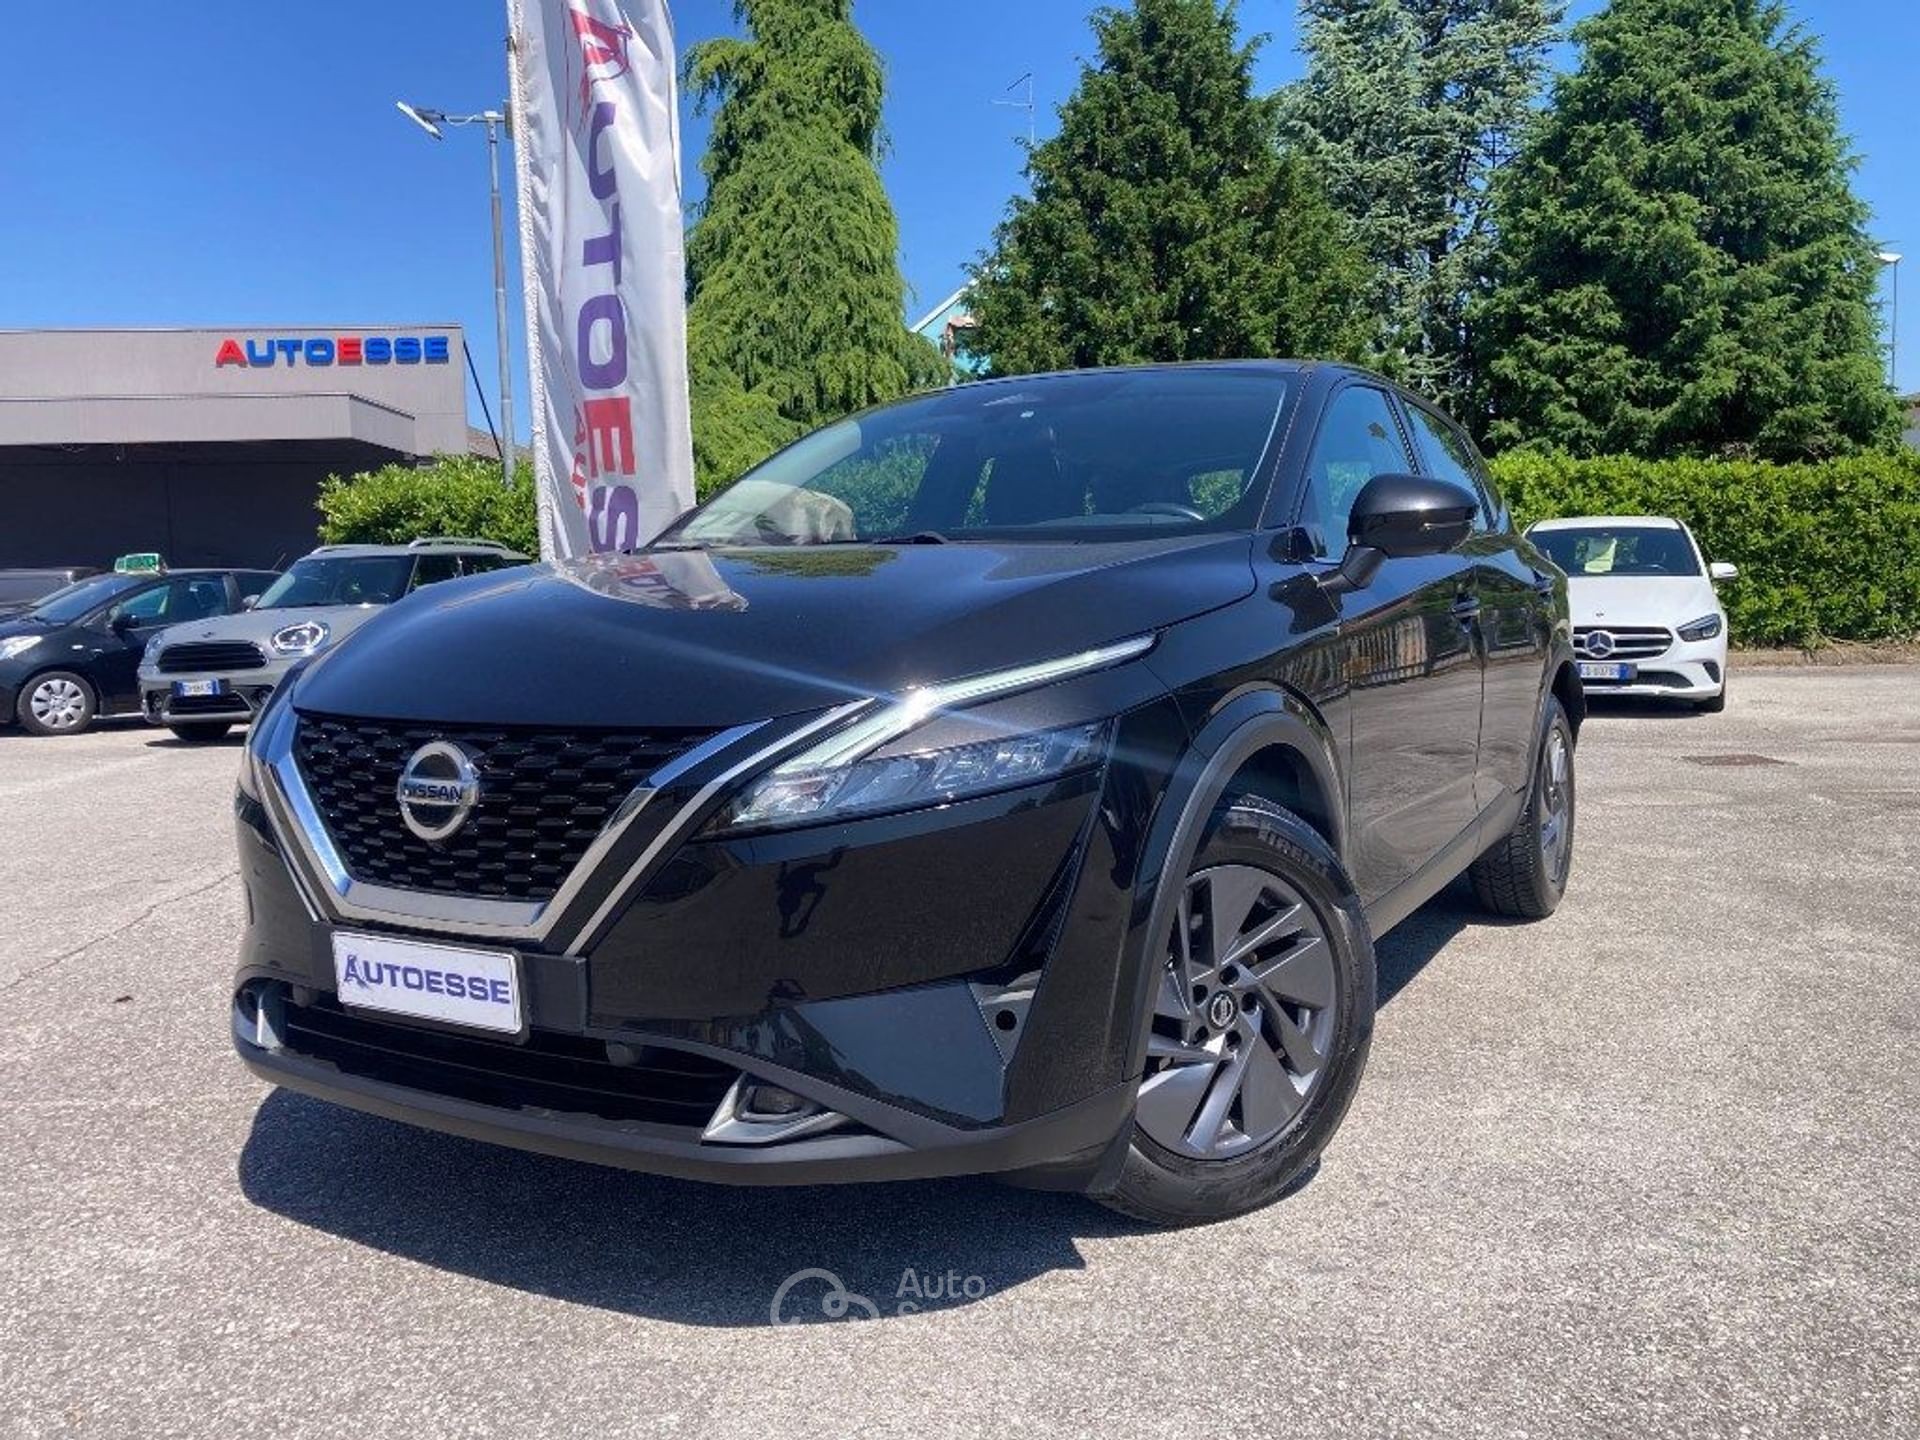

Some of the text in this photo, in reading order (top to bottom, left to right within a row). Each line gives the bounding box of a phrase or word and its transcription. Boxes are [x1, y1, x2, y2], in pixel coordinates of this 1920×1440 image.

[216, 336, 449, 368] AUTOESSE
[402, 782, 464, 802] NISSAN
[343, 954, 511, 1005] AUTOESSE
